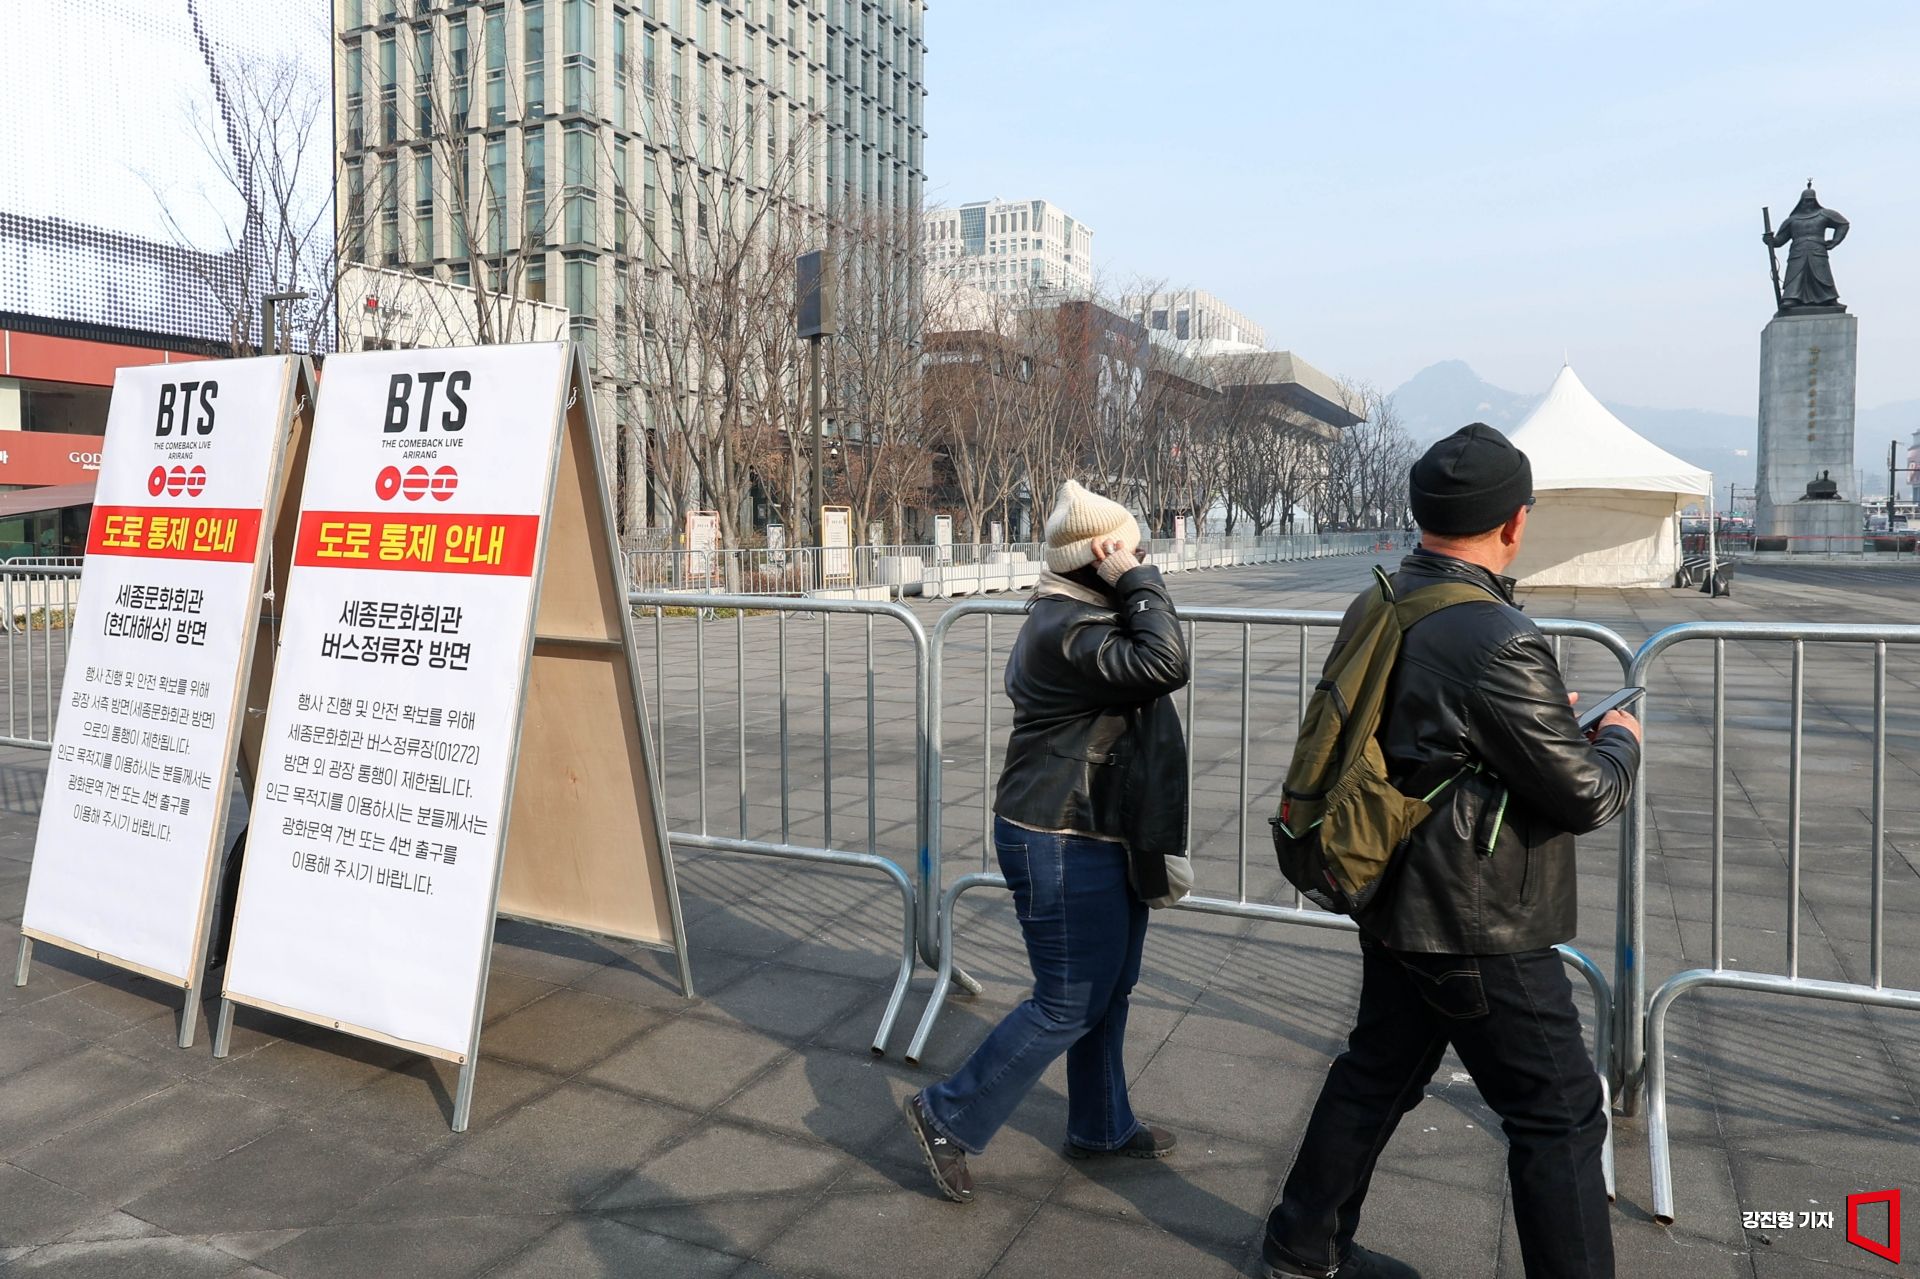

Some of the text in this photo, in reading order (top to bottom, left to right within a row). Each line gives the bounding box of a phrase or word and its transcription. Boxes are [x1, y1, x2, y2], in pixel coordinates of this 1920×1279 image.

[155, 380, 219, 437] BTS
[383, 370, 472, 433] BTS
[154, 440, 212, 450] THE COMEBACK LIVE
[168, 451, 193, 460] ARIRANG
[381, 438, 464, 448] THE COMEBACK LIVE
[402, 450, 437, 459] ARIRANG
[102, 515, 238, 553] 도로 통제 안내
[316, 522, 505, 565] 도로 통제 안내
[115, 584, 204, 614] 세종문화회관
[338, 600, 463, 635] 세종문화회관
[175, 619, 208, 646] 방면
[321, 632, 471, 671] 버스정류장 방면
[71, 691, 90, 709] 광장
[91, 695, 110, 711] 서측
[85, 666, 210, 698] 행사 진행 및 안전 확보를 위해
[297, 693, 476, 731] 행사 진행 및 안전 확보를 위해
[82, 721, 190, 755] 으로의 통행이 제한됩니다.
[287, 723, 364, 750] 세종문화회관
[57, 743, 212, 790] 인근 목적지를 이용하시는 분들께서는
[283, 754, 473, 798] 방면 외 광장 통행이 제한됩니다.
[68, 774, 191, 816] 광화문역 7번 또는 4번 출구를
[265, 782, 488, 836] 인근 목적지를 이용하시는 분들께서는
[73, 803, 171, 842] 이용해 주시기 바랍니다.
[282, 816, 458, 865] 광화문역 7번 또는 4번 출구를
[292, 851, 433, 895] 이용해 주시기 바랍니다.
